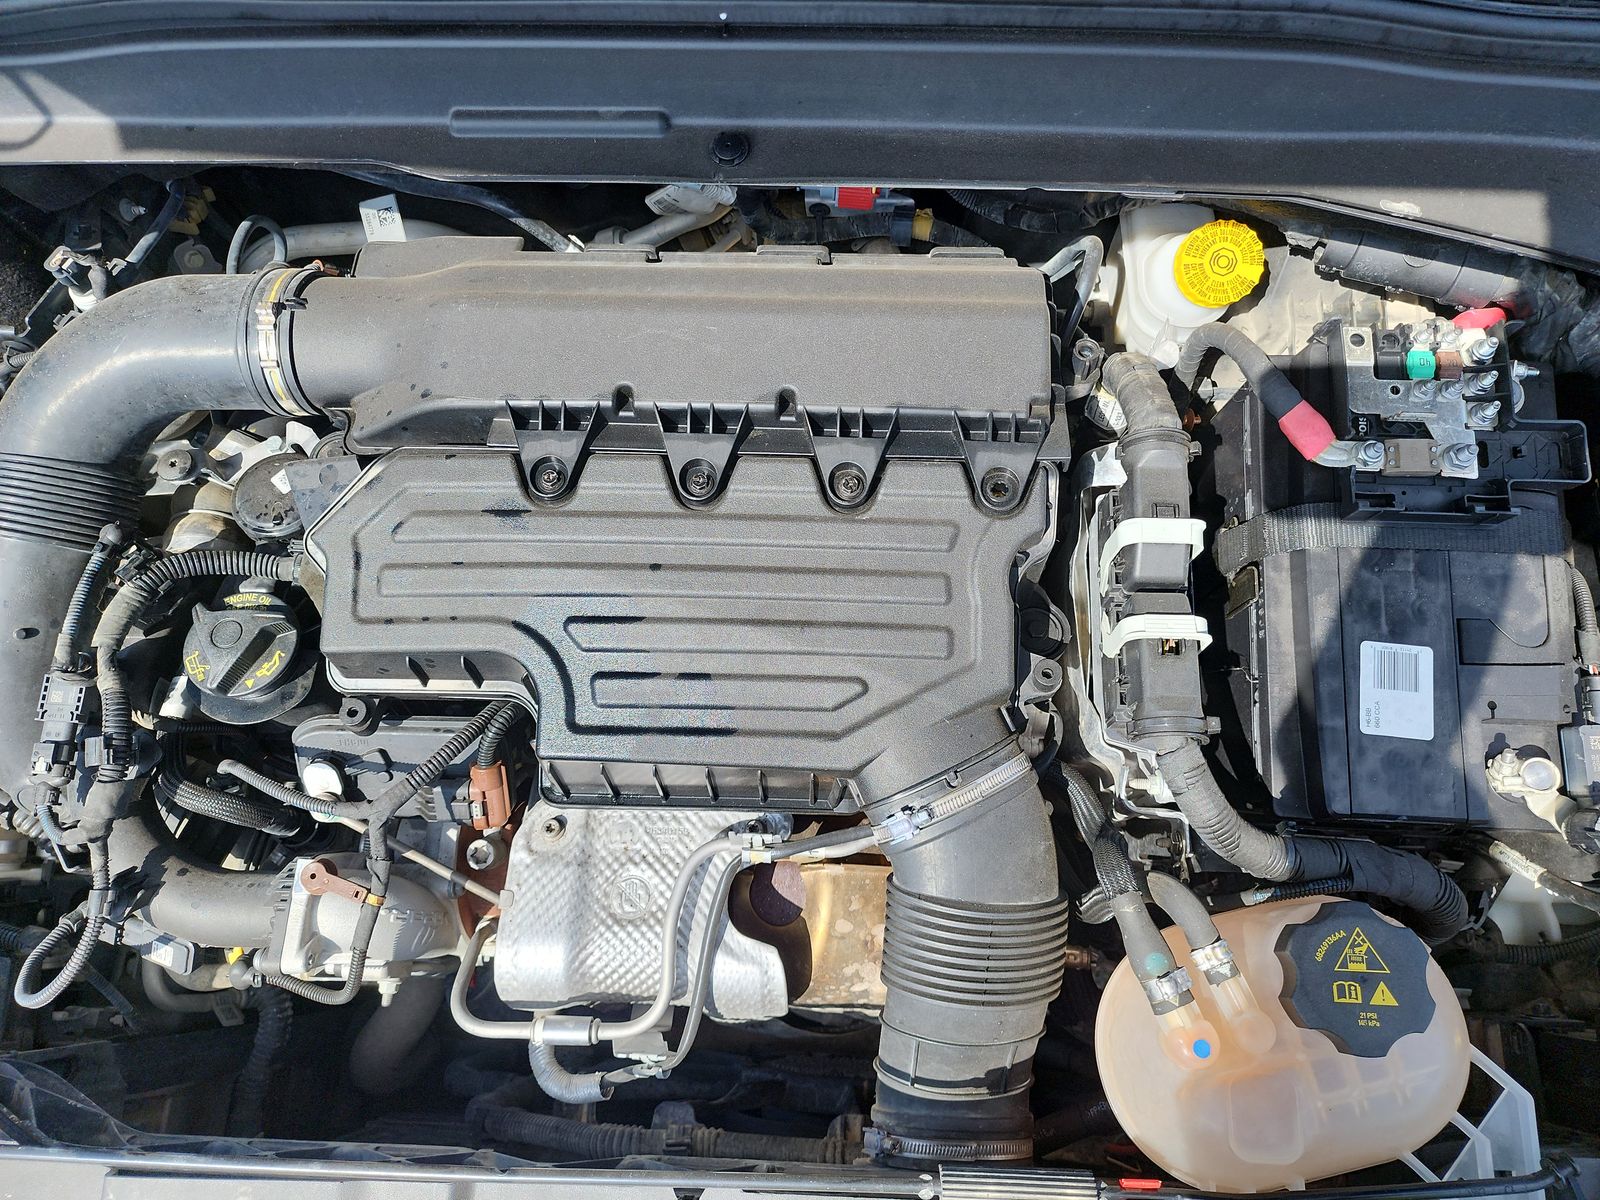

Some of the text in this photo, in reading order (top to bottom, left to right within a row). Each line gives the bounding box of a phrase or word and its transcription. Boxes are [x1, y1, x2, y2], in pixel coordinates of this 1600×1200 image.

[1212, 294, 1231, 303] SEALED
[1232, 279, 1257, 300] CONTAINER
[1420, 358, 1430, 367] 40
[223, 593, 272, 606] ENGINE OIL
